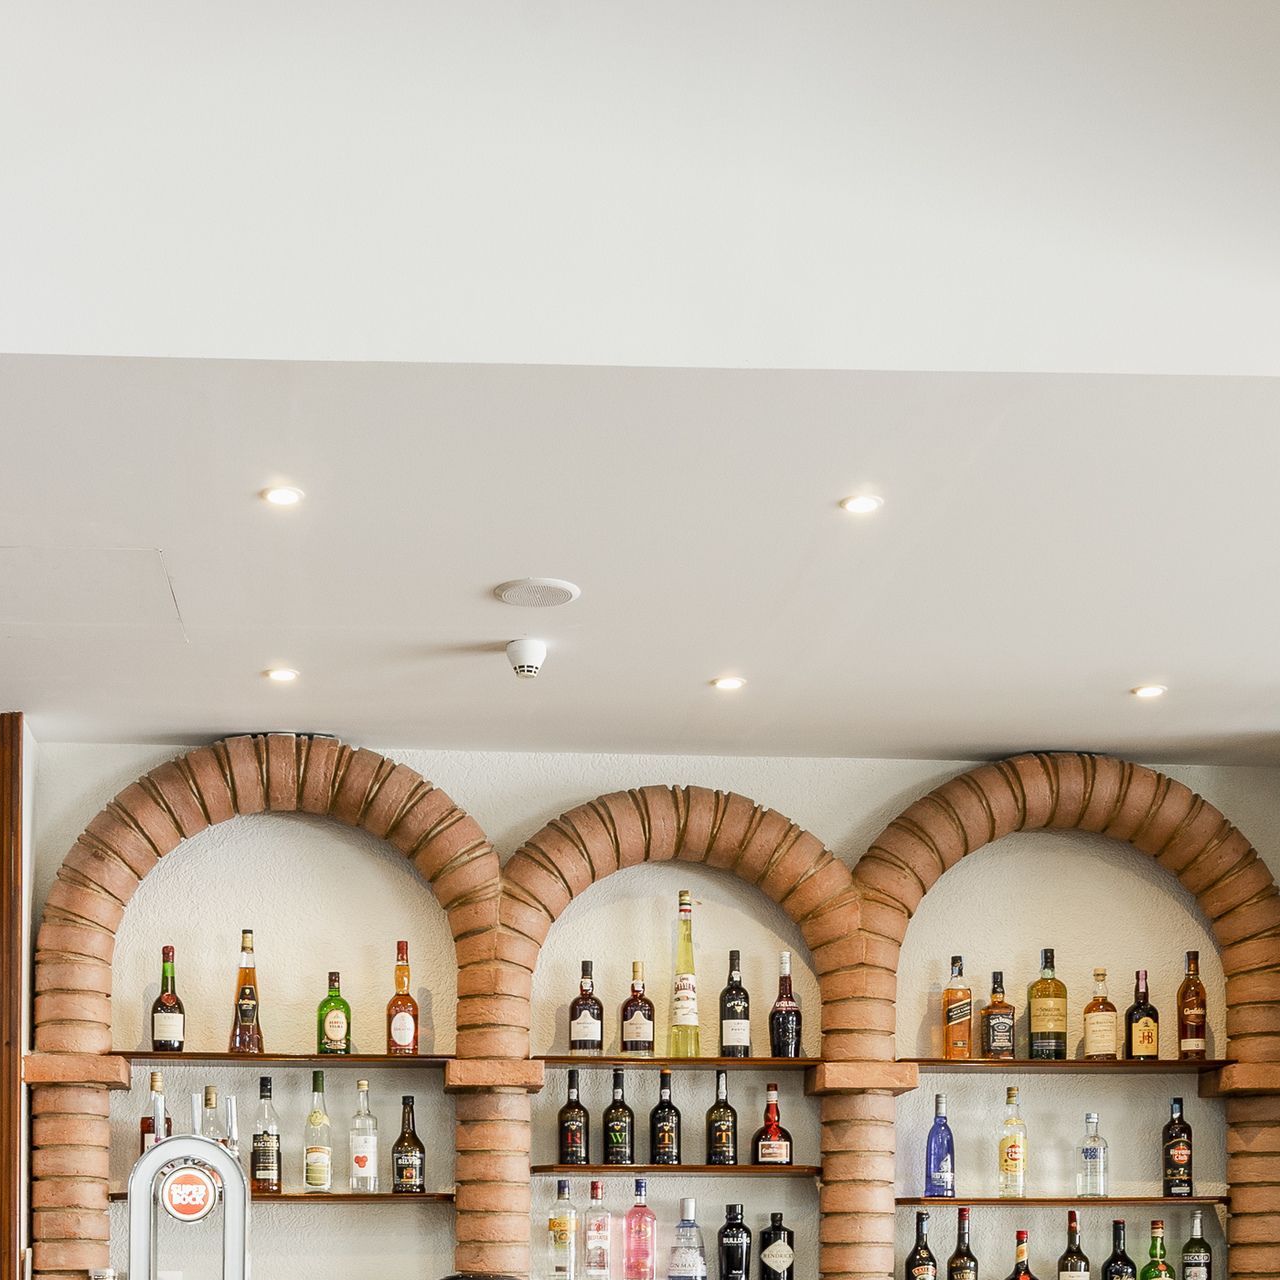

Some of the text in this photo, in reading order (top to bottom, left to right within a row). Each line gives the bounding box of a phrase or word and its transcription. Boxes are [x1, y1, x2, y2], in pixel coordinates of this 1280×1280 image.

[609, 1132, 628, 1143] W
[658, 1132, 675, 1144] T
[716, 1131, 732, 1143] T
[170, 1183, 207, 1194] SUPER
[171, 1193, 205, 1205] BOCK
